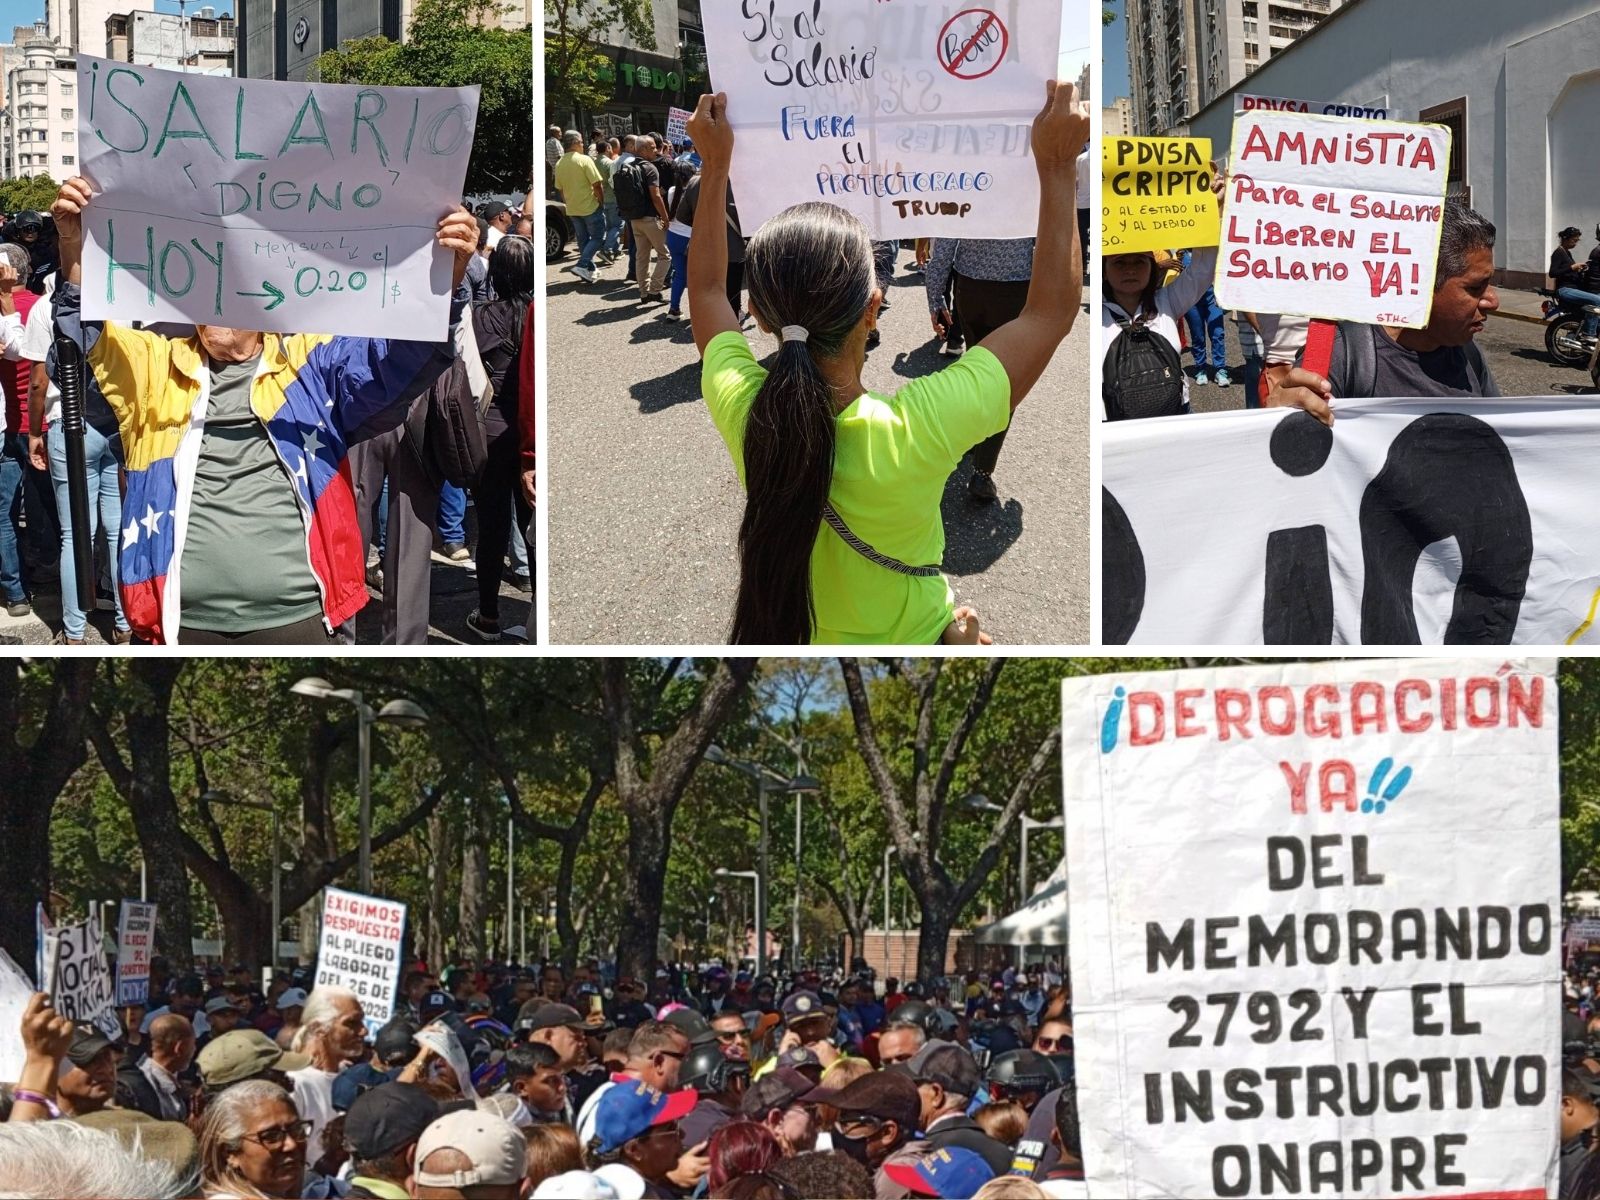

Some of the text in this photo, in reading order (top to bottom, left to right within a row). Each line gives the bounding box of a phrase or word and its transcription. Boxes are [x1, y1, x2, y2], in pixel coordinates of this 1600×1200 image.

[781, 105, 856, 141] FUERA
[1117, 140, 1203, 166] PDVSA
[816, 171, 994, 198] PROTECTORADO
[1112, 170, 1211, 196] CRIPTO
[1120, 206, 1134, 216] AL
[1140, 204, 1187, 215] ESTADO
[1194, 204, 1208, 213] DE
[1133, 221, 1147, 231] AL
[1153, 219, 1195, 230] DEBIDO
[1370, 232, 1411, 255] EL
[107, 218, 224, 316] HOY
[294, 266, 368, 298] 0.20
[1362, 260, 1420, 298] YA!
[1100, 663, 1545, 754] ¡DEROGACIÓN
[1279, 757, 1413, 814] YA!!
[1266, 834, 1385, 892] DEL
[327, 895, 400, 923] EXIGIMOS
[325, 914, 400, 941] RESPUESTA
[1146, 903, 1552, 974] MEMORANDO
[326, 934, 395, 962] AL PLIEGO
[325, 953, 390, 981] LABORAL
[371, 984, 390, 1001] DE
[1168, 982, 1482, 1048] 2792 Y EL
[1144, 1055, 1547, 1125] INSTRUCTIVO
[1211, 1133, 1467, 1198] ONAPRE
